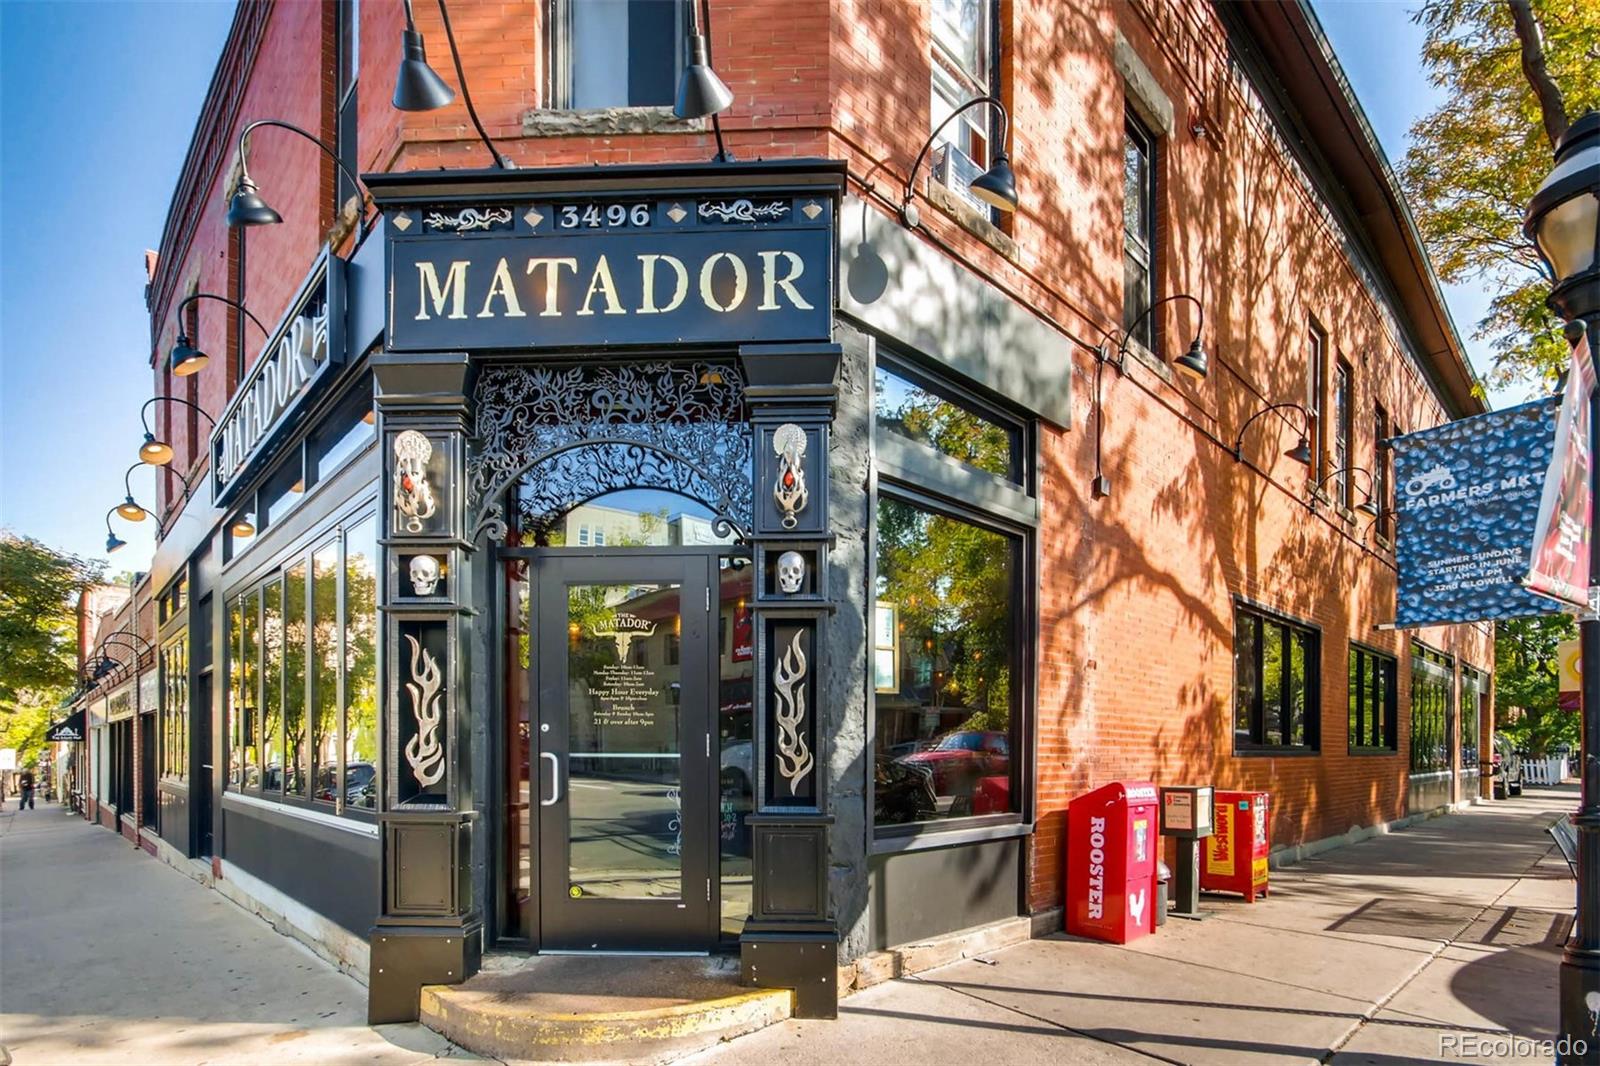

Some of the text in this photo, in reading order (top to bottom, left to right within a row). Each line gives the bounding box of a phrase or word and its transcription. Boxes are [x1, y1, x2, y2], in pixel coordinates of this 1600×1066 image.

[560, 203, 650, 228] 3496
[414, 249, 815, 321] MATADOR
[222, 315, 313, 484] MATADOR
[1405, 482, 1494, 511] FARMERS
[1500, 471, 1546, 491] MKT
[1427, 547, 1523, 569] SUMMER SUNDAYS
[1427, 562, 1477, 577] STARTING
[1479, 560, 1491, 569] IN
[1492, 555, 1522, 567] JUNE
[1434, 581, 1459, 592] 32nd
[1470, 575, 1514, 588] LOWELL
[600, 618, 649, 630] MATADOR
[588, 688, 610, 697] Happy
[630, 687, 660, 697] Everyday
[1213, 804, 1230, 862] Westword
[1088, 816, 1105, 919] ROOSTER
